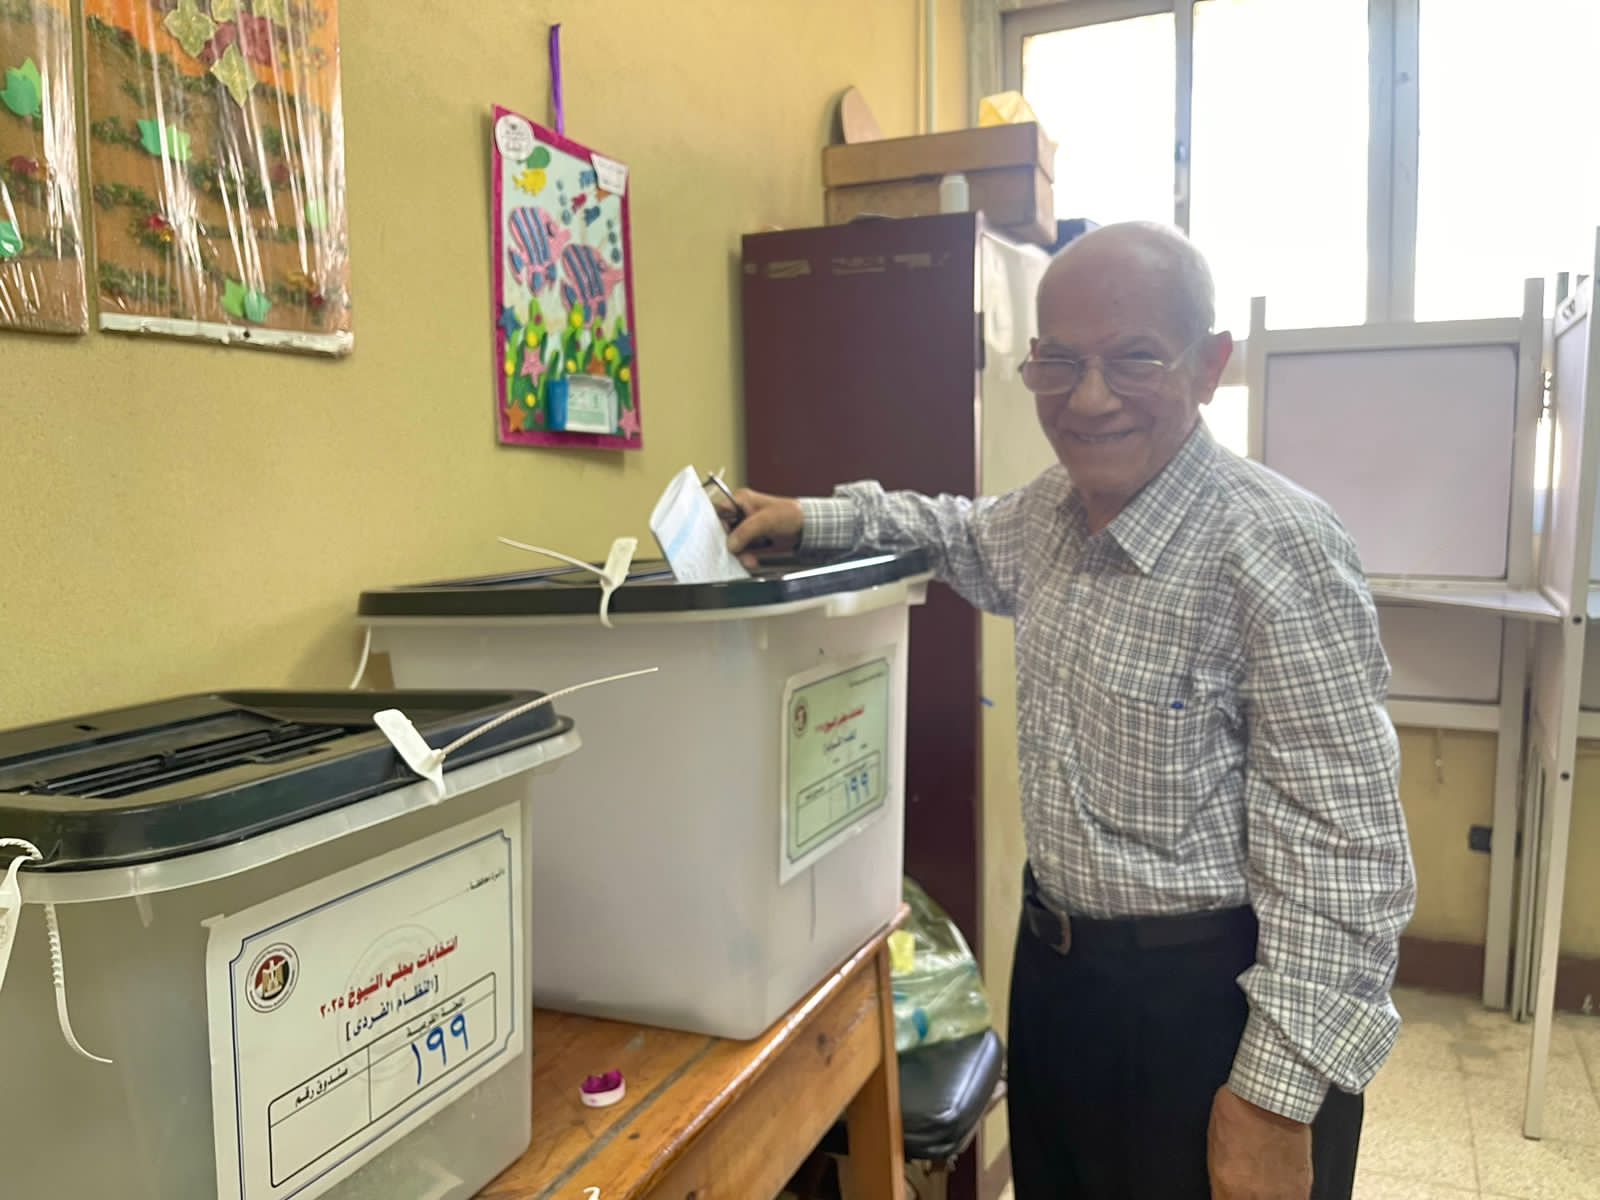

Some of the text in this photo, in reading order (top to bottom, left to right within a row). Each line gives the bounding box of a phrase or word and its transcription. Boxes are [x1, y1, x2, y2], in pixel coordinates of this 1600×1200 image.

[320, 936, 458, 1019] انتخابات مجلس الشيوخ ٢٠٢٥
[411, 1012, 470, 1086] ١٩٩
[295, 1066, 349, 1109] صندوق رقم
